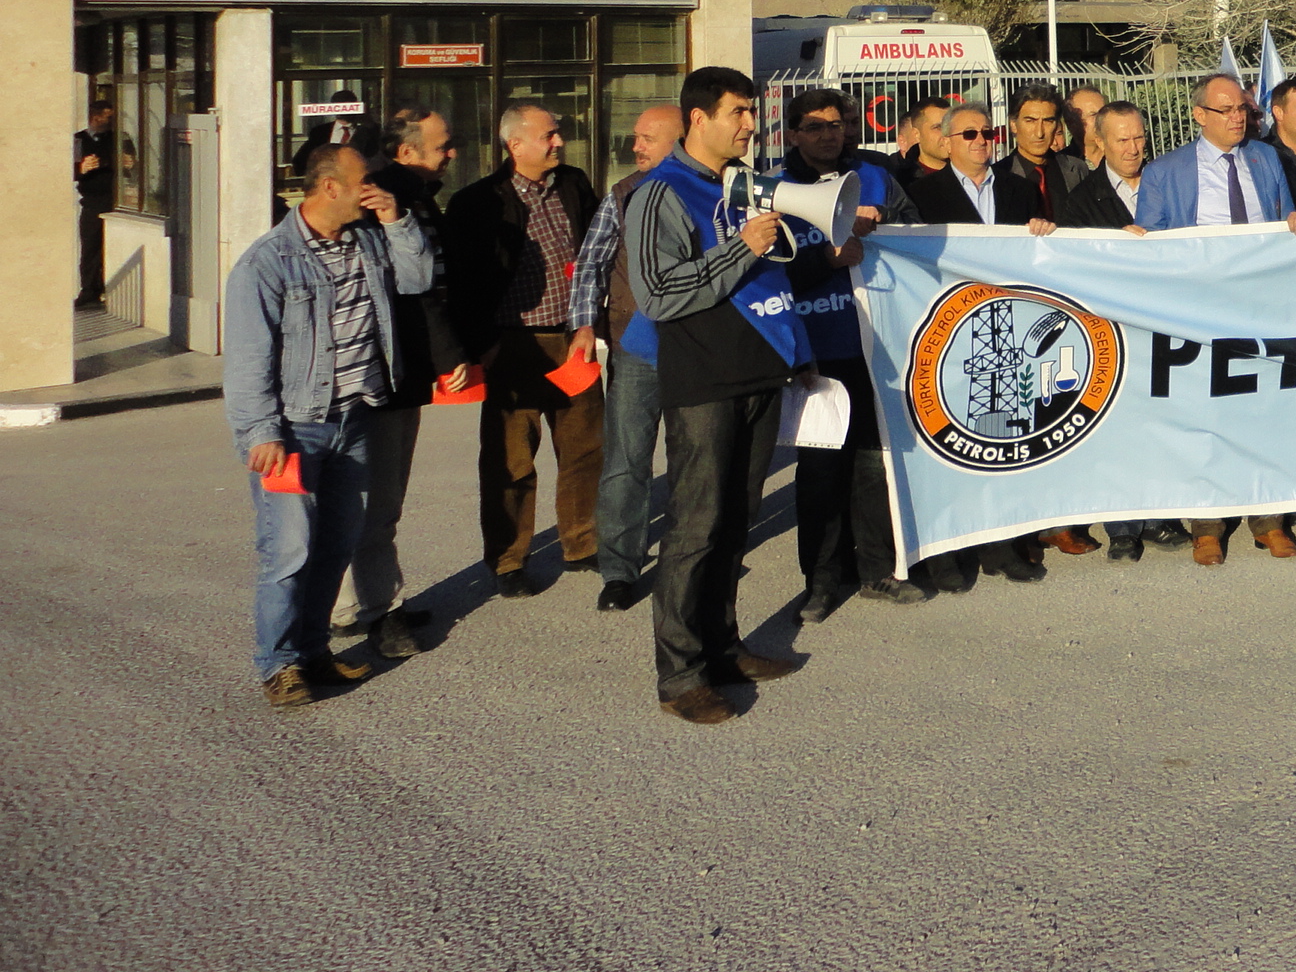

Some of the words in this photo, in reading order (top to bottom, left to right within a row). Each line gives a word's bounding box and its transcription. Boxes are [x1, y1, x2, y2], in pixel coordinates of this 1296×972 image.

[860, 42, 965, 60] AMBULANS
[302, 103, 360, 114] MÜRACAAT
[926, 305, 964, 366] PETROL
[917, 357, 937, 418] TÜRKİYE
[1089, 330, 1111, 400] SENDİKASI
[943, 430, 1031, 462] PETROL-İŞ
[1042, 413, 1087, 450] 1950
